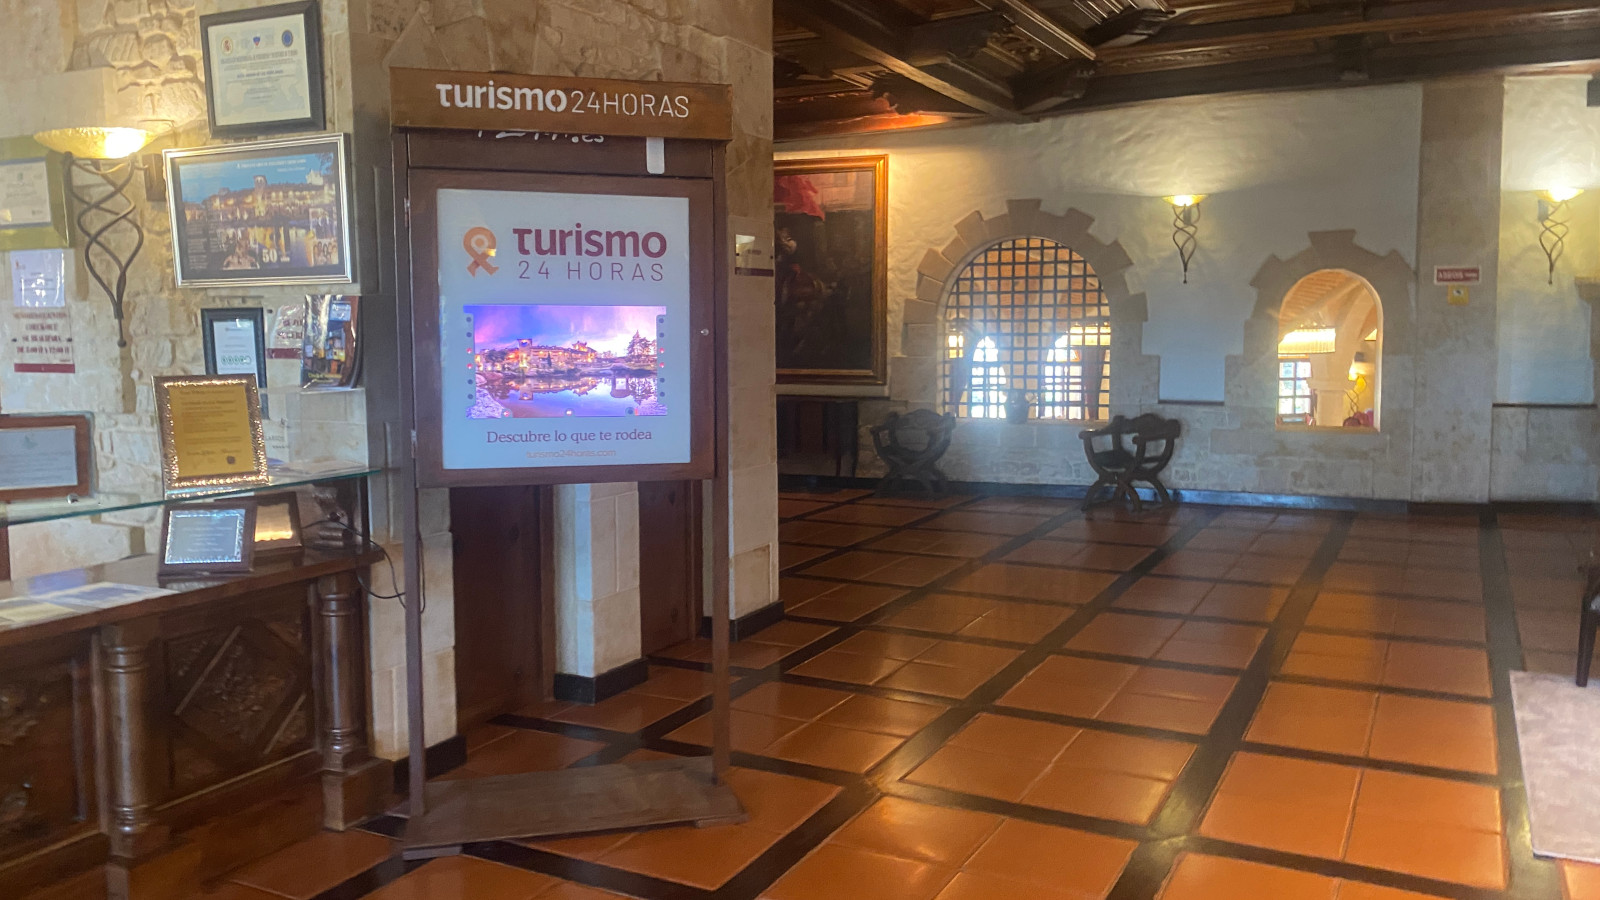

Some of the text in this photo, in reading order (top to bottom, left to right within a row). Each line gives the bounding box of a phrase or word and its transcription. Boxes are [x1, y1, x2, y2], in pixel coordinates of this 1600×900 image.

[512, 222, 668, 258] turismo
[262, 248, 278, 263] 50
[518, 260, 664, 281] 24 HORAS
[486, 428, 652, 444] Descubre lo que te rodea
